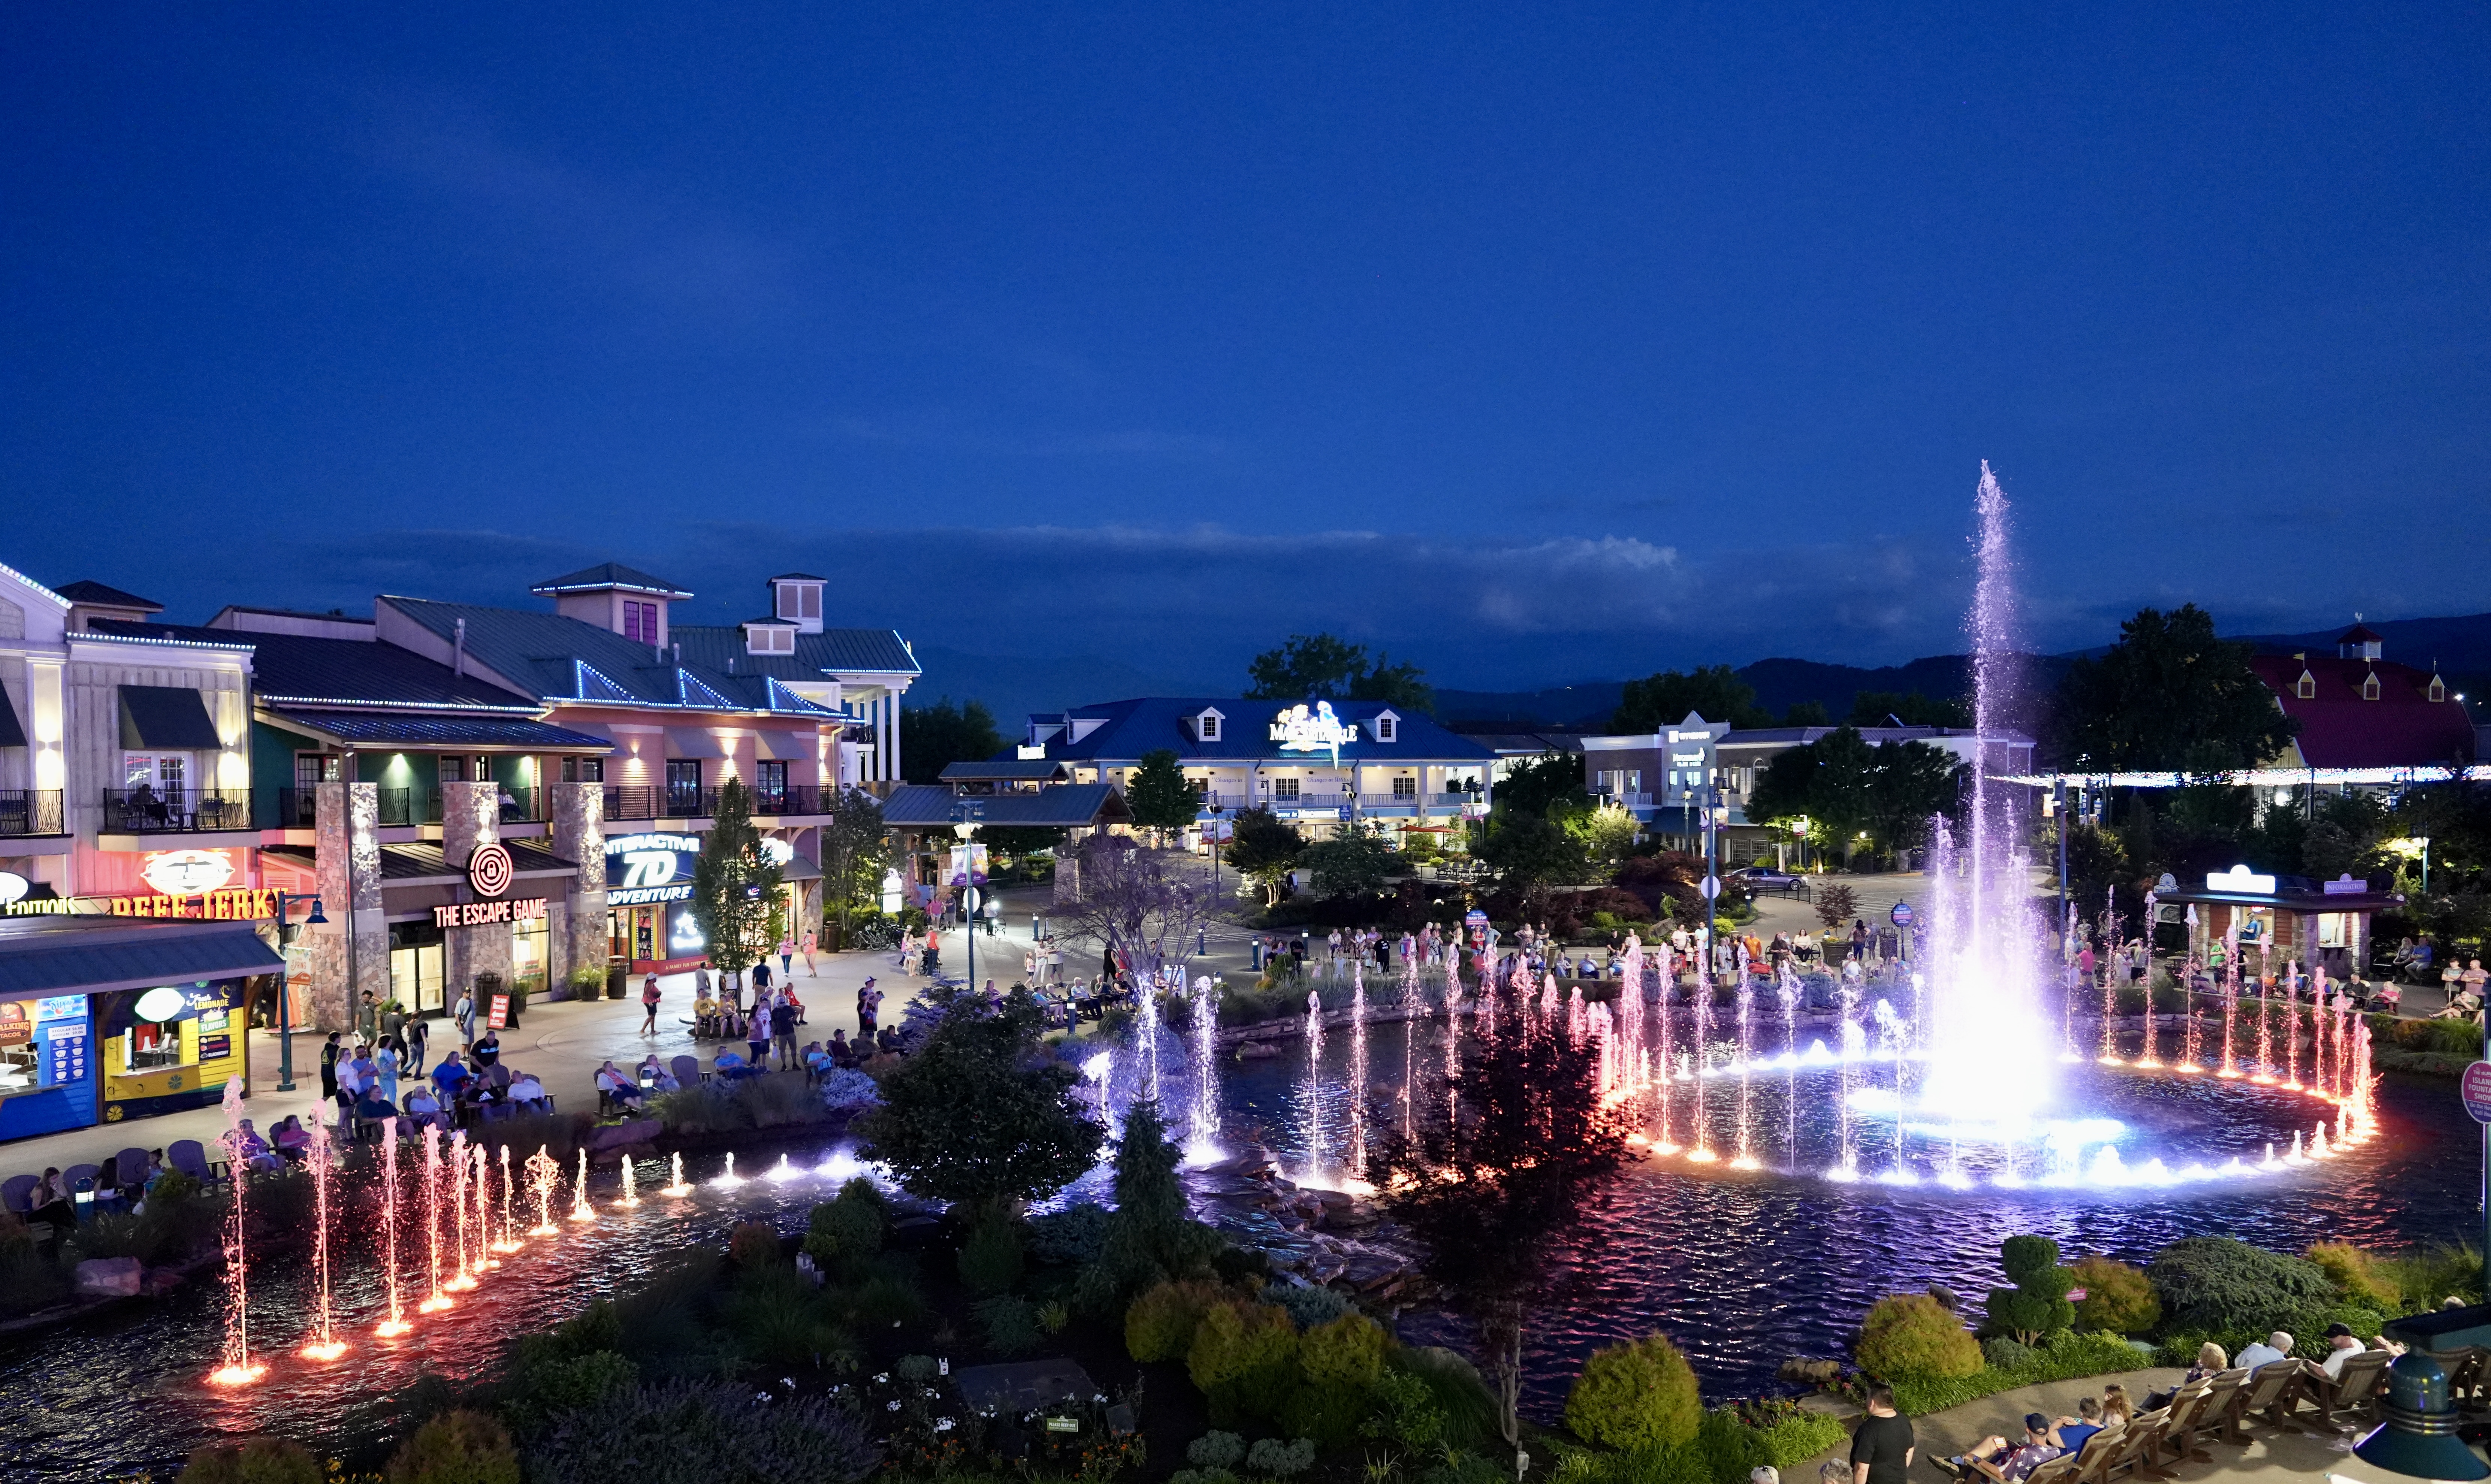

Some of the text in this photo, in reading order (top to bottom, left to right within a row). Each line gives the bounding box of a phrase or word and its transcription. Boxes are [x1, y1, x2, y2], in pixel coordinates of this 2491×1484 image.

[603, 834, 700, 855] NTERACTIVE
[623, 851, 677, 888] 7D
[112, 894, 187, 918] BEEF
[434, 898, 547, 928] THE ESCAPE GAME
[194, 998, 229, 1010] LEMONADE
[201, 1019, 227, 1032] FLAVORS
[2473, 1076, 2491, 1086] ISLAN
